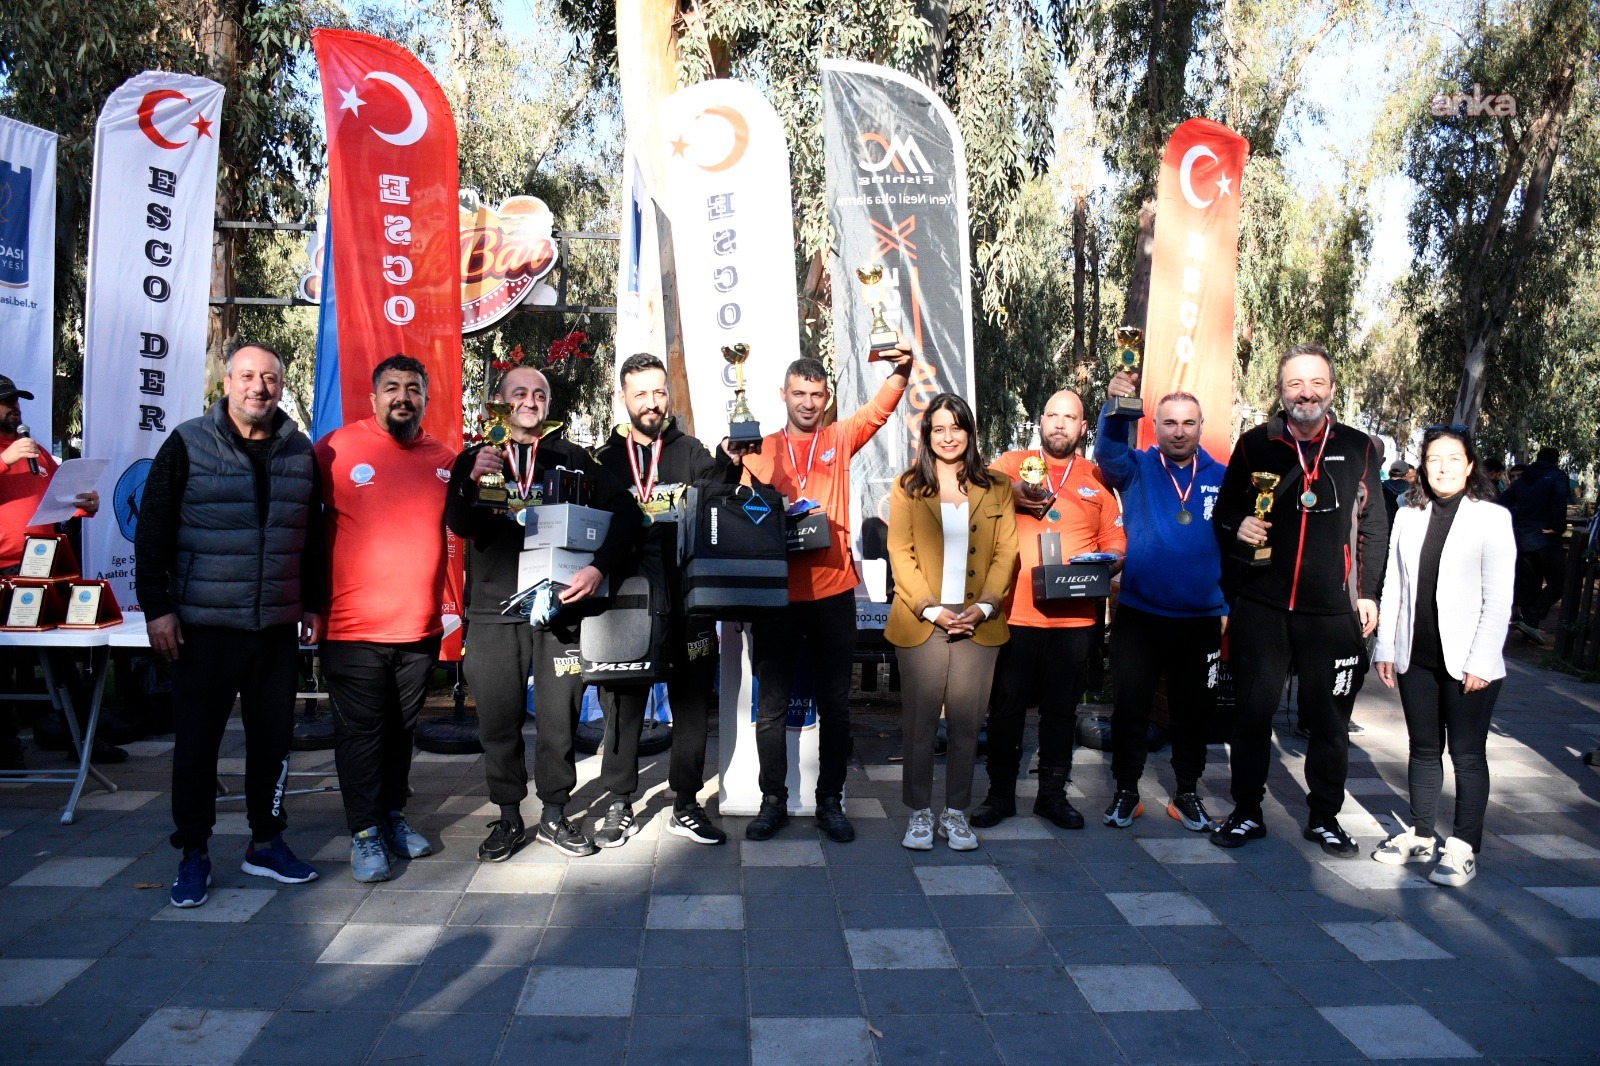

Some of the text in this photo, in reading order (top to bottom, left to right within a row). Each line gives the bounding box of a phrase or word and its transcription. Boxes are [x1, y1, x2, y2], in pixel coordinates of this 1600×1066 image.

[461, 227, 554, 283] Bar
[139, 166, 177, 432] ESCO DER
[710, 507, 718, 545] SHIMANO
[1055, 574, 1099, 584] FLIEGEN
[586, 661, 652, 673] YASEI
[1333, 655, 1359, 669] yuki
